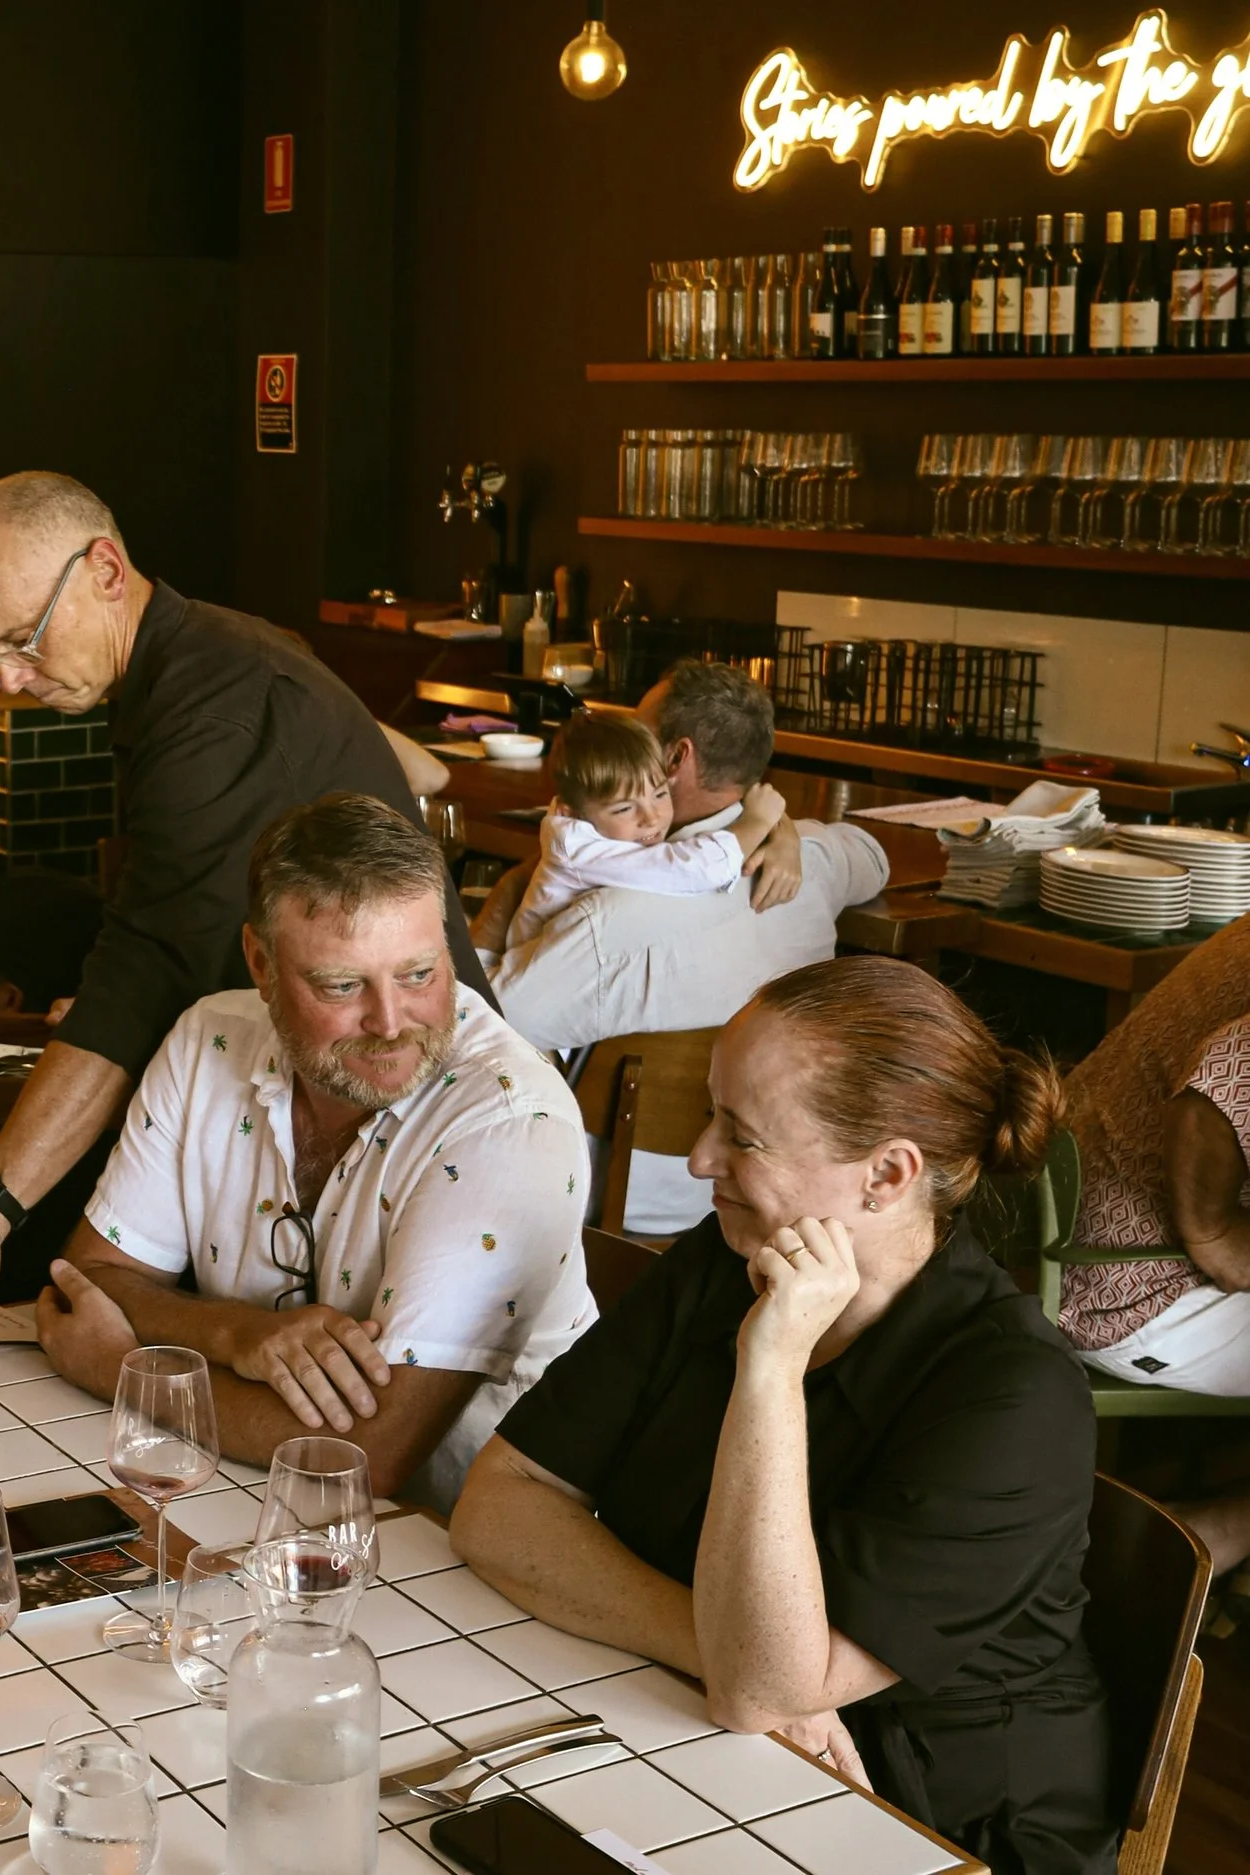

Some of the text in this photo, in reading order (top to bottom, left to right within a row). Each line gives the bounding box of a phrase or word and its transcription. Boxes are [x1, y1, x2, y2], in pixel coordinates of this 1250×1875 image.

[737, 53, 872, 187] Stories
[1030, 32, 1104, 167] by
[1097, 17, 1197, 130] the
[328, 1521, 358, 1545] BAR
